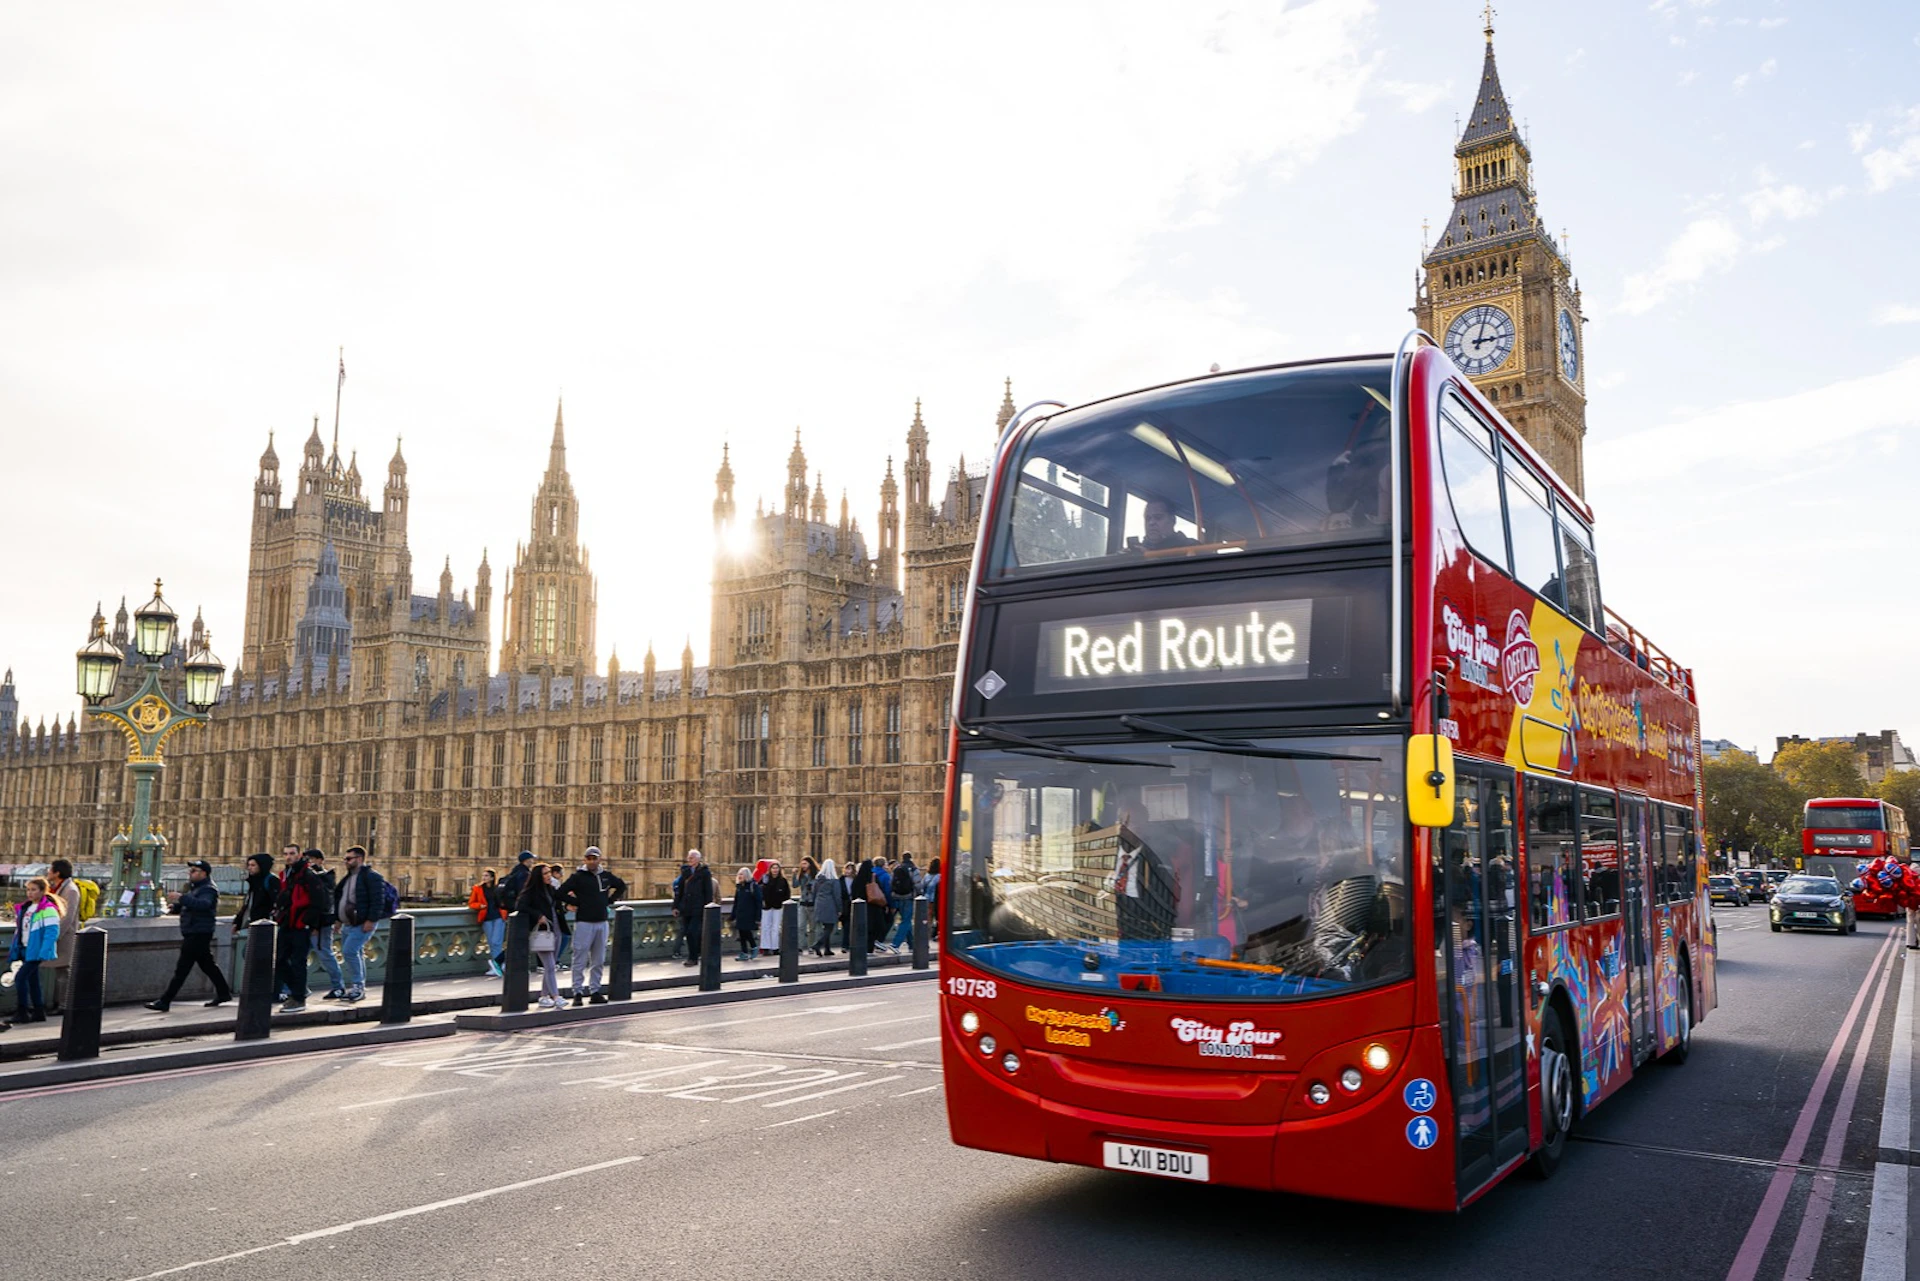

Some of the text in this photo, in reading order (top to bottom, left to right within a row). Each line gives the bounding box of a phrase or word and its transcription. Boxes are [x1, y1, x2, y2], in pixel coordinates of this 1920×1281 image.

[1064, 611, 1296, 677] Red Route
[1442, 604, 1475, 660] City
[1475, 623, 1500, 666] Tour
[1858, 835, 1872, 844] 26
[947, 976, 998, 999] 19758
[1170, 1017, 1282, 1046] City Tour
[1199, 1042, 1253, 1057] LONDON
[1118, 1146, 1192, 1175] LX11 BDU
